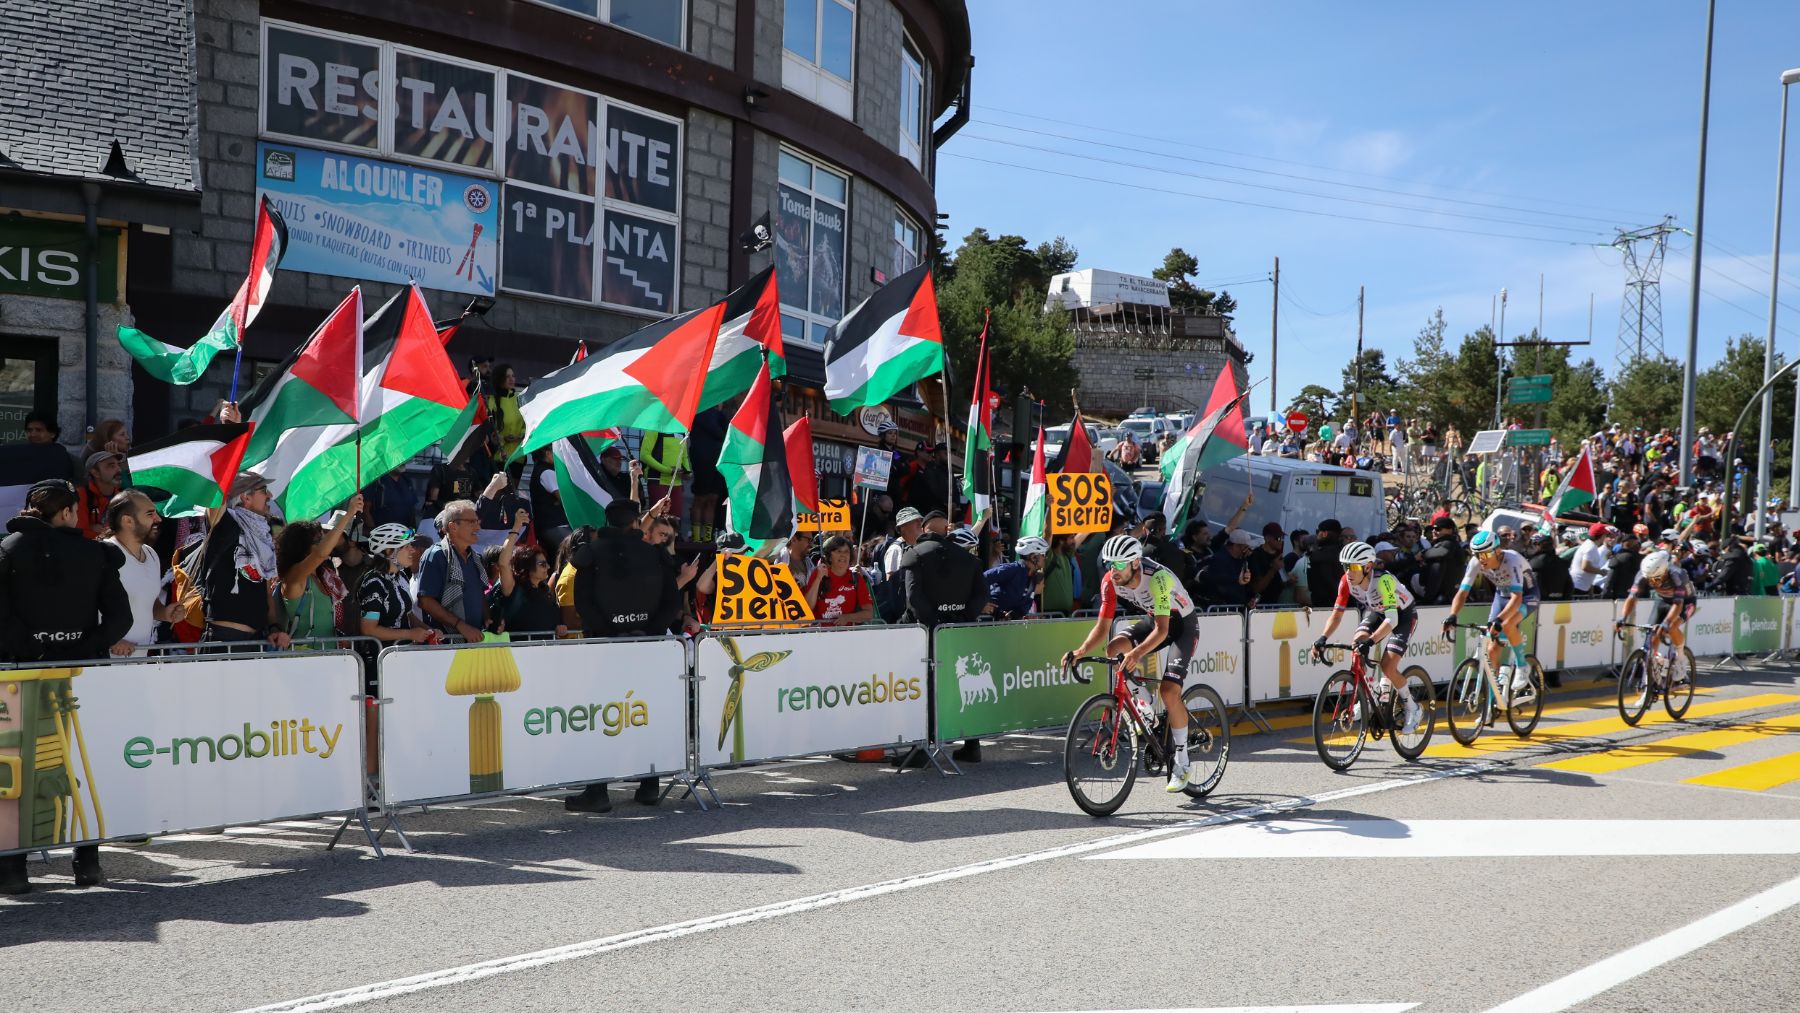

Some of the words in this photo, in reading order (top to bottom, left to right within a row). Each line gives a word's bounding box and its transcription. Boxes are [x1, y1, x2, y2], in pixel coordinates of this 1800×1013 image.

[278, 52, 671, 188] RESTAURANTE
[321, 157, 442, 206] ALQUILER
[780, 192, 842, 233] Tomahawk
[320, 210, 391, 250] SNOWBOARD
[406, 238, 452, 265] TRINEOS
[321, 235, 359, 258] RAQUETAS
[386, 258, 402, 275] CON
[546, 206, 669, 263] PLANTA
[1056, 474, 1109, 507] SOS
[797, 511, 842, 524] sierra
[1056, 506, 1110, 527] sierra
[722, 556, 793, 600] SOS
[612, 613, 648, 624] 4G1C123
[720, 596, 806, 621] sierra
[778, 671, 922, 713] renovables
[1003, 662, 1094, 697] plenitude
[523, 689, 649, 737] energía
[123, 717, 343, 769] e-mobility
